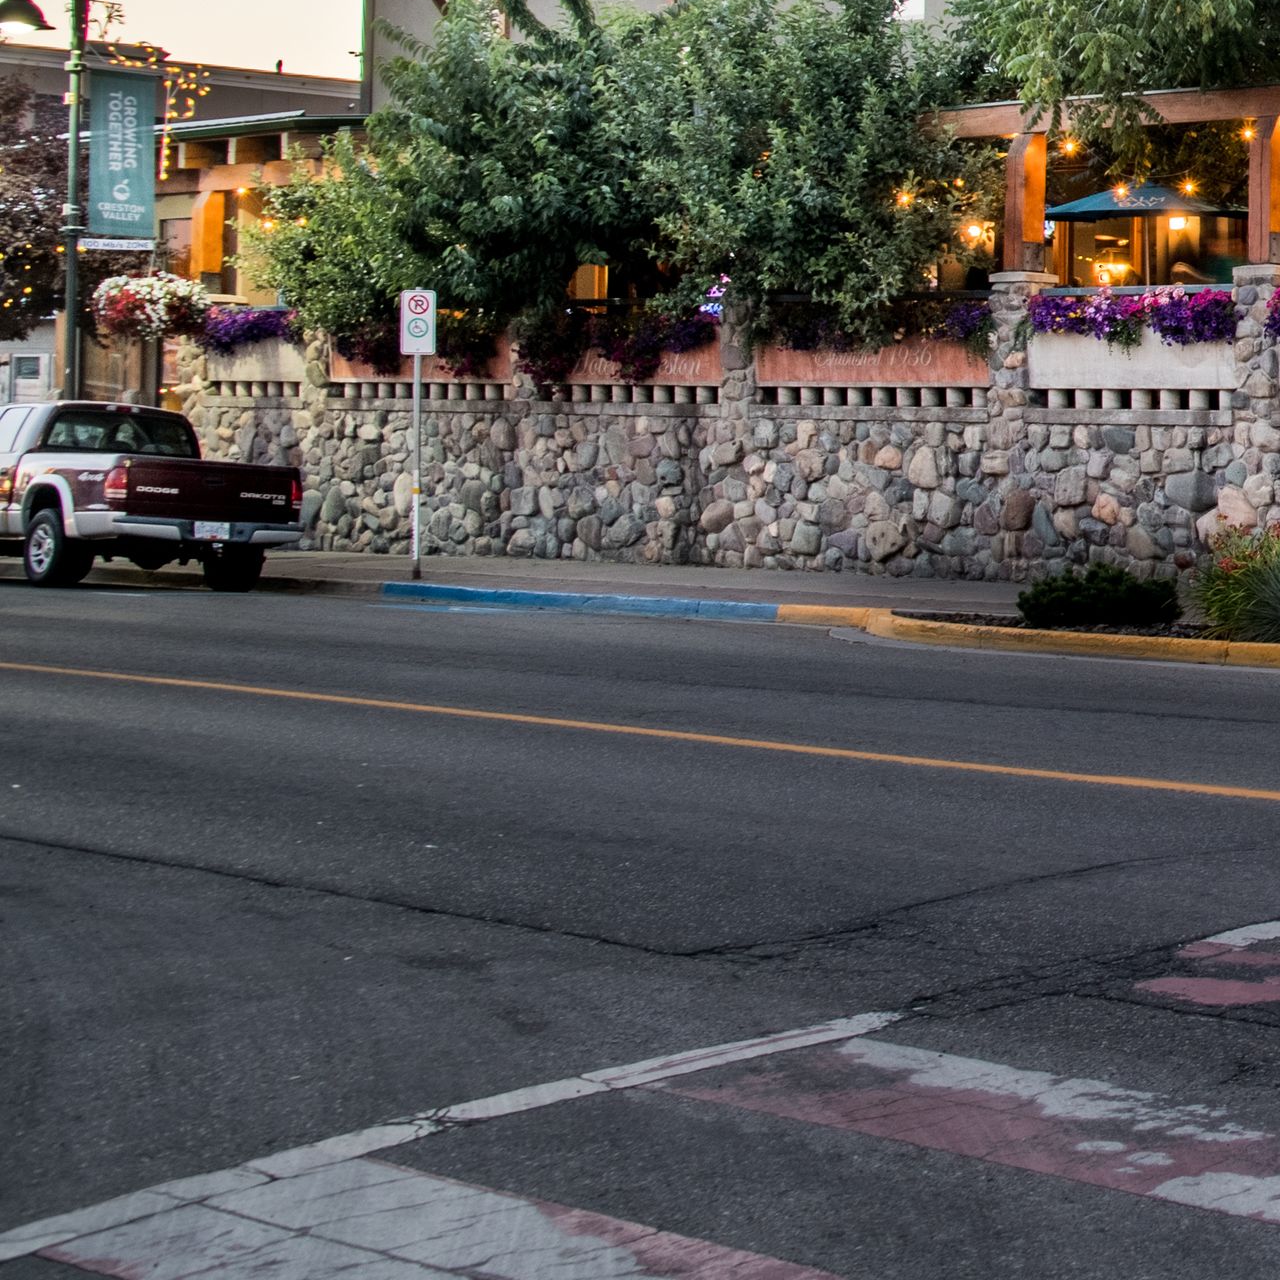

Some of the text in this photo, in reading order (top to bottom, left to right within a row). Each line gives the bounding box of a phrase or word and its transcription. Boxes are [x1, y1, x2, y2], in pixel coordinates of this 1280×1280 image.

[108, 91, 123, 171] TOGETHER
[123, 96, 138, 169] GROWING
[97, 201, 145, 214] CRESTON
[102, 210, 142, 222] VALLEY
[126, 241, 150, 249] ZONE
[135, 485, 180, 495] DODGE
[239, 492, 287, 501] DAKOTA
